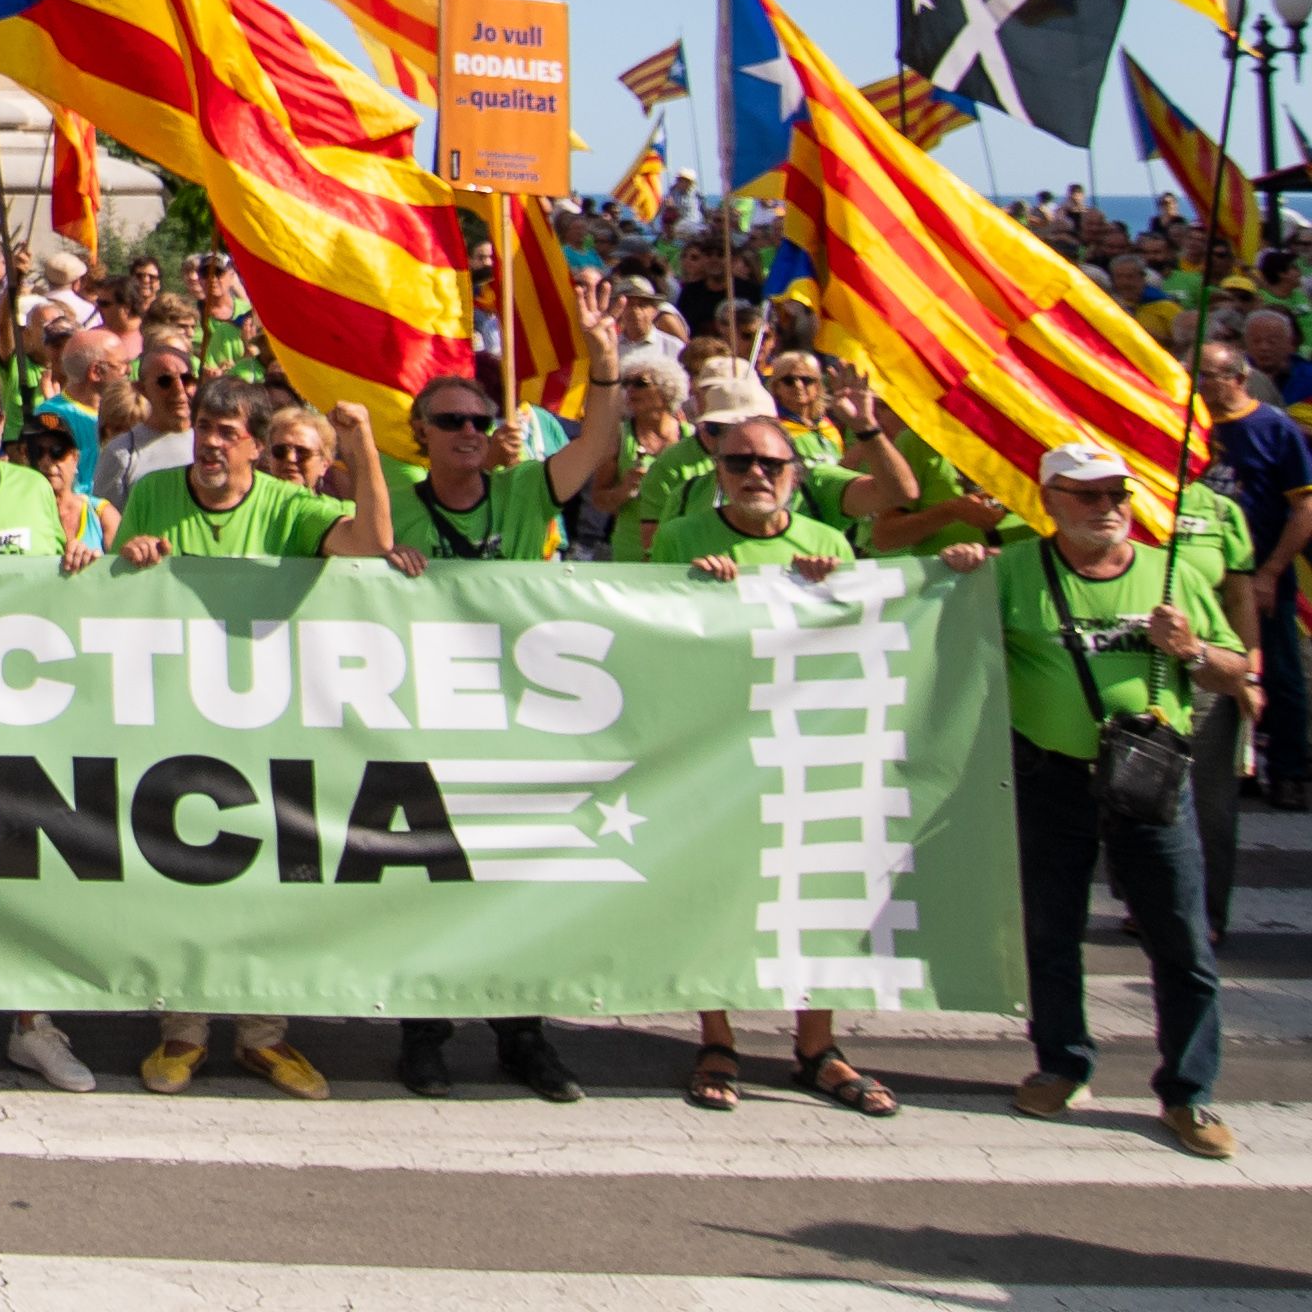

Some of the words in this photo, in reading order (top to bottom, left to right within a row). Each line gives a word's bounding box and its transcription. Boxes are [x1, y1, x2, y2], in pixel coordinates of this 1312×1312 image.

[472, 22, 496, 42] Jo
[503, 26, 543, 46] vull
[454, 52, 564, 84] RODALIES
[470, 89, 557, 114] qualitat
